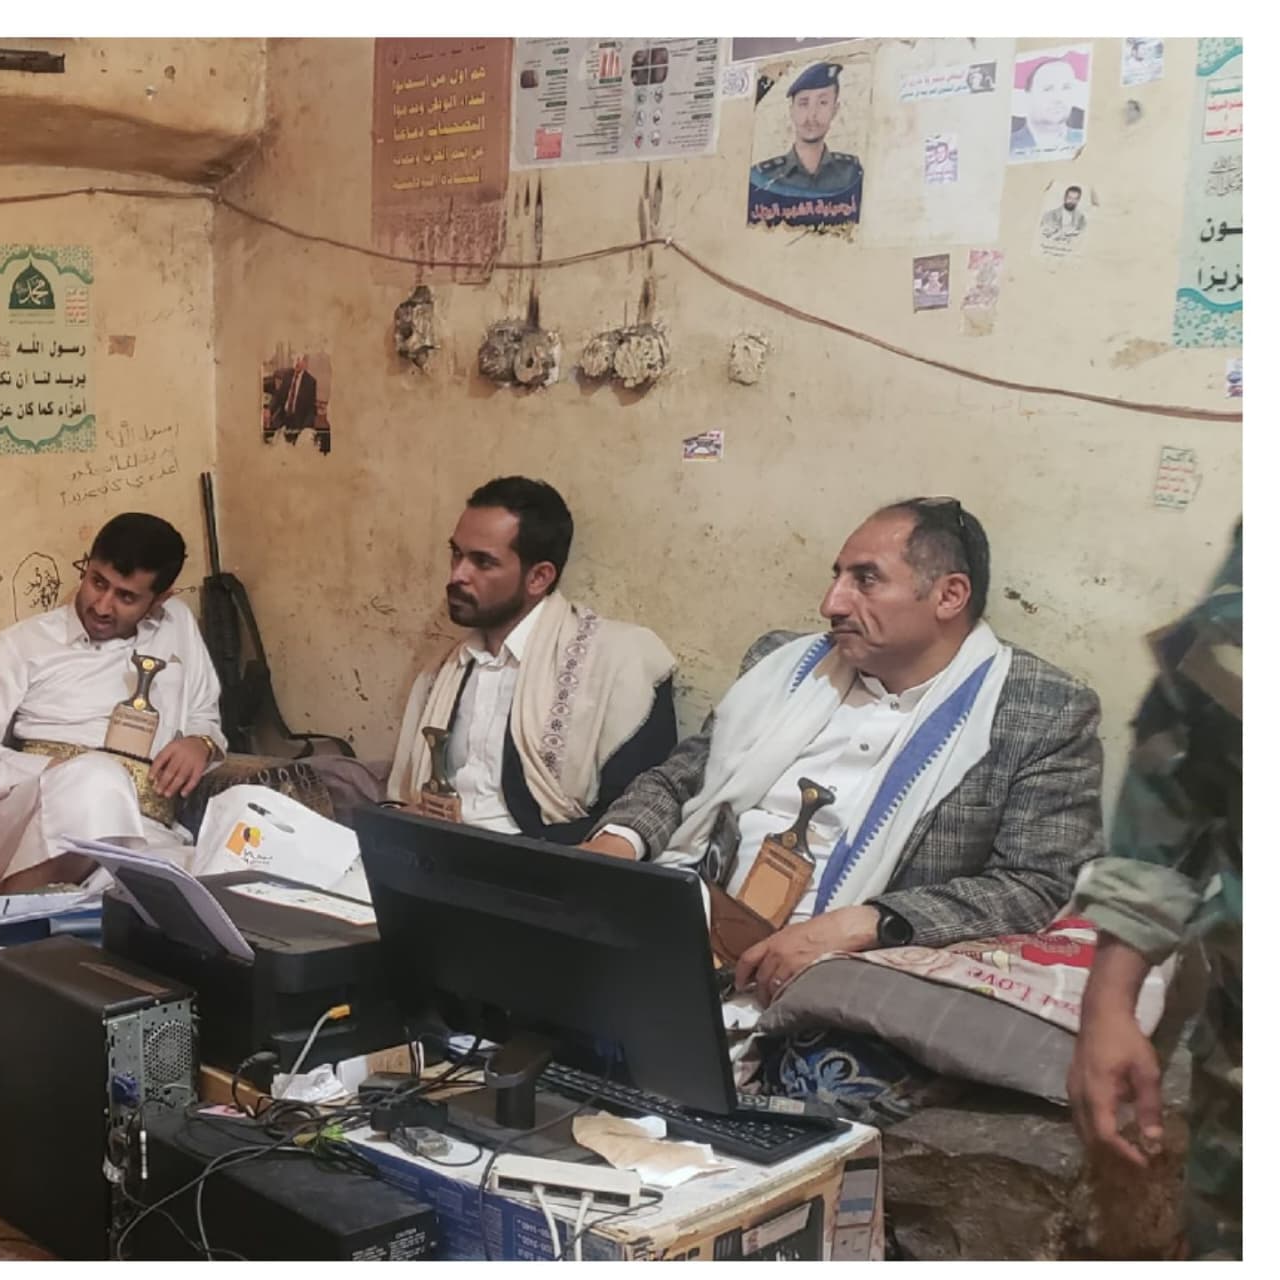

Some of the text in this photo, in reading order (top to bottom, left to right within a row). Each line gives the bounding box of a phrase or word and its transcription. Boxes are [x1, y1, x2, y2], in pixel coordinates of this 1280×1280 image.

[16, 332, 44, 354] الله
[49, 340, 86, 358] رسول
[32, 371, 51, 384] لنا
[55, 371, 86, 389] يريد
[17, 402, 34, 419] كان
[38, 401, 54, 415] كما
